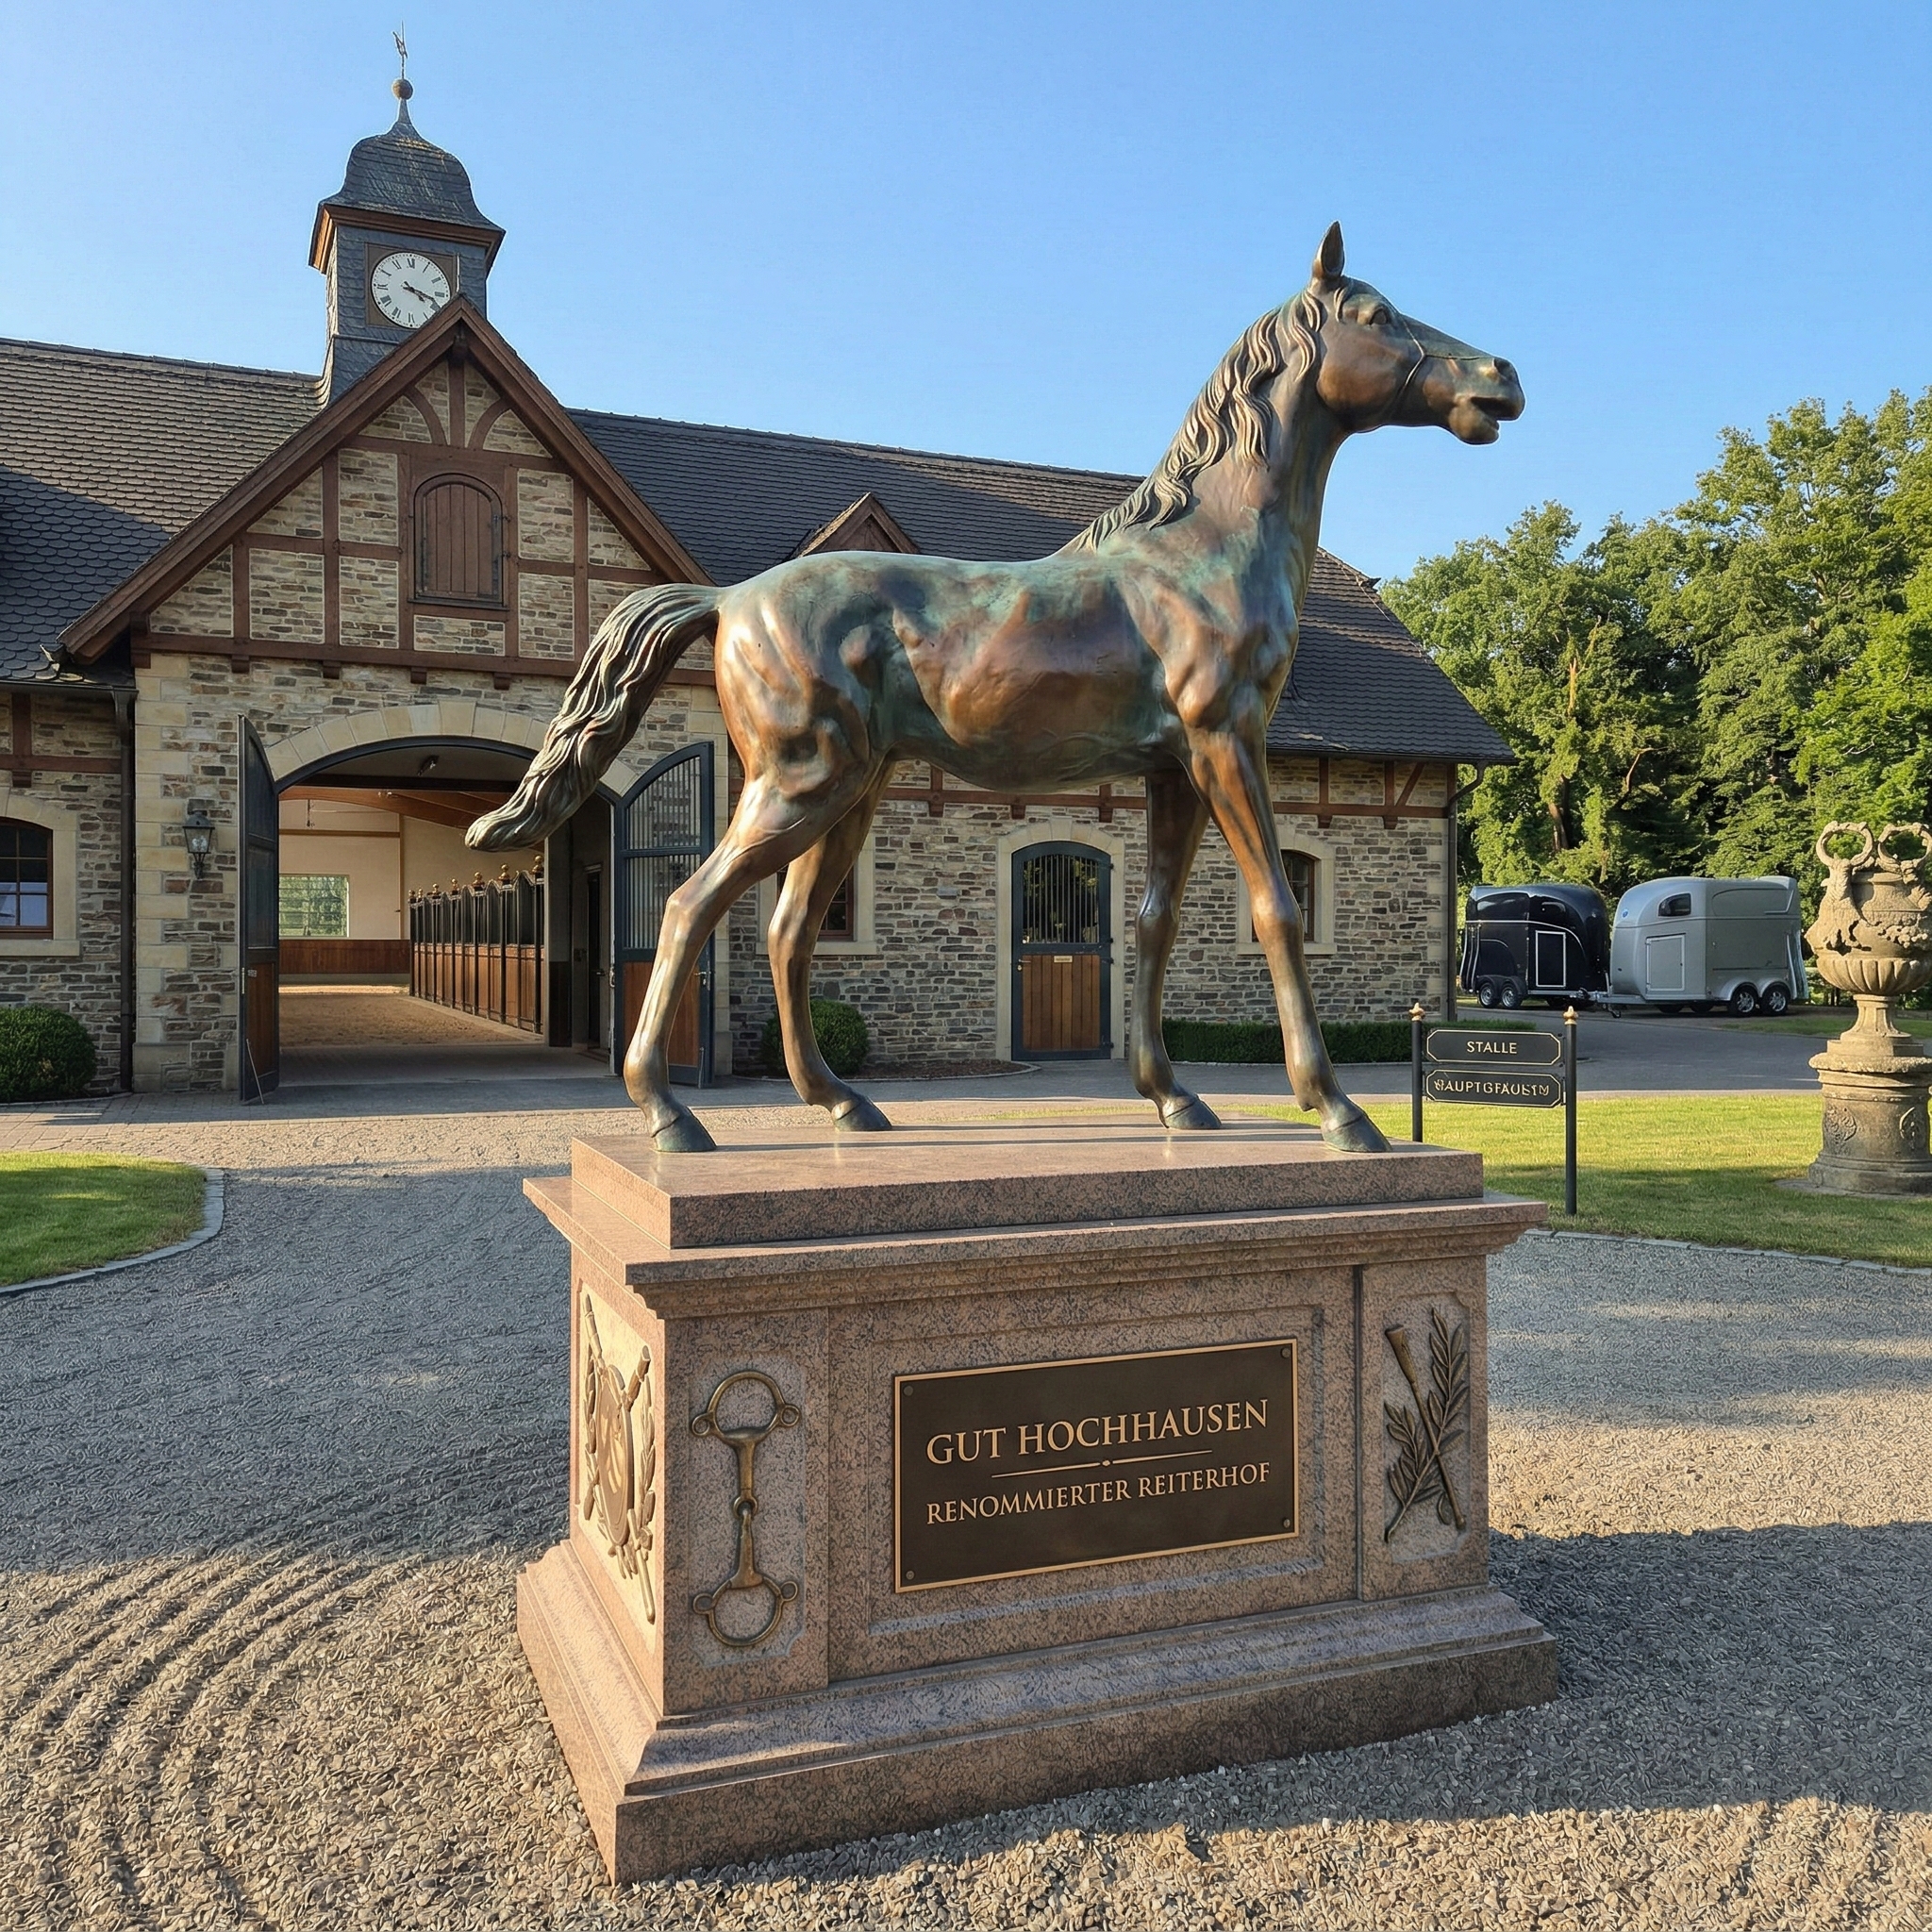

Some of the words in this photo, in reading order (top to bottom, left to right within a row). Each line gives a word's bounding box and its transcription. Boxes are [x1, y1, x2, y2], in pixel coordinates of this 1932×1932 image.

[1467, 1041, 1517, 1054] STALLE
[926, 1428, 1006, 1464] GUT
[1018, 1398, 1269, 1457] HOCHHAUSEN
[926, 1479, 1132, 1524] RENOMMIERTER
[1138, 1461, 1271, 1499] REITERHOF
